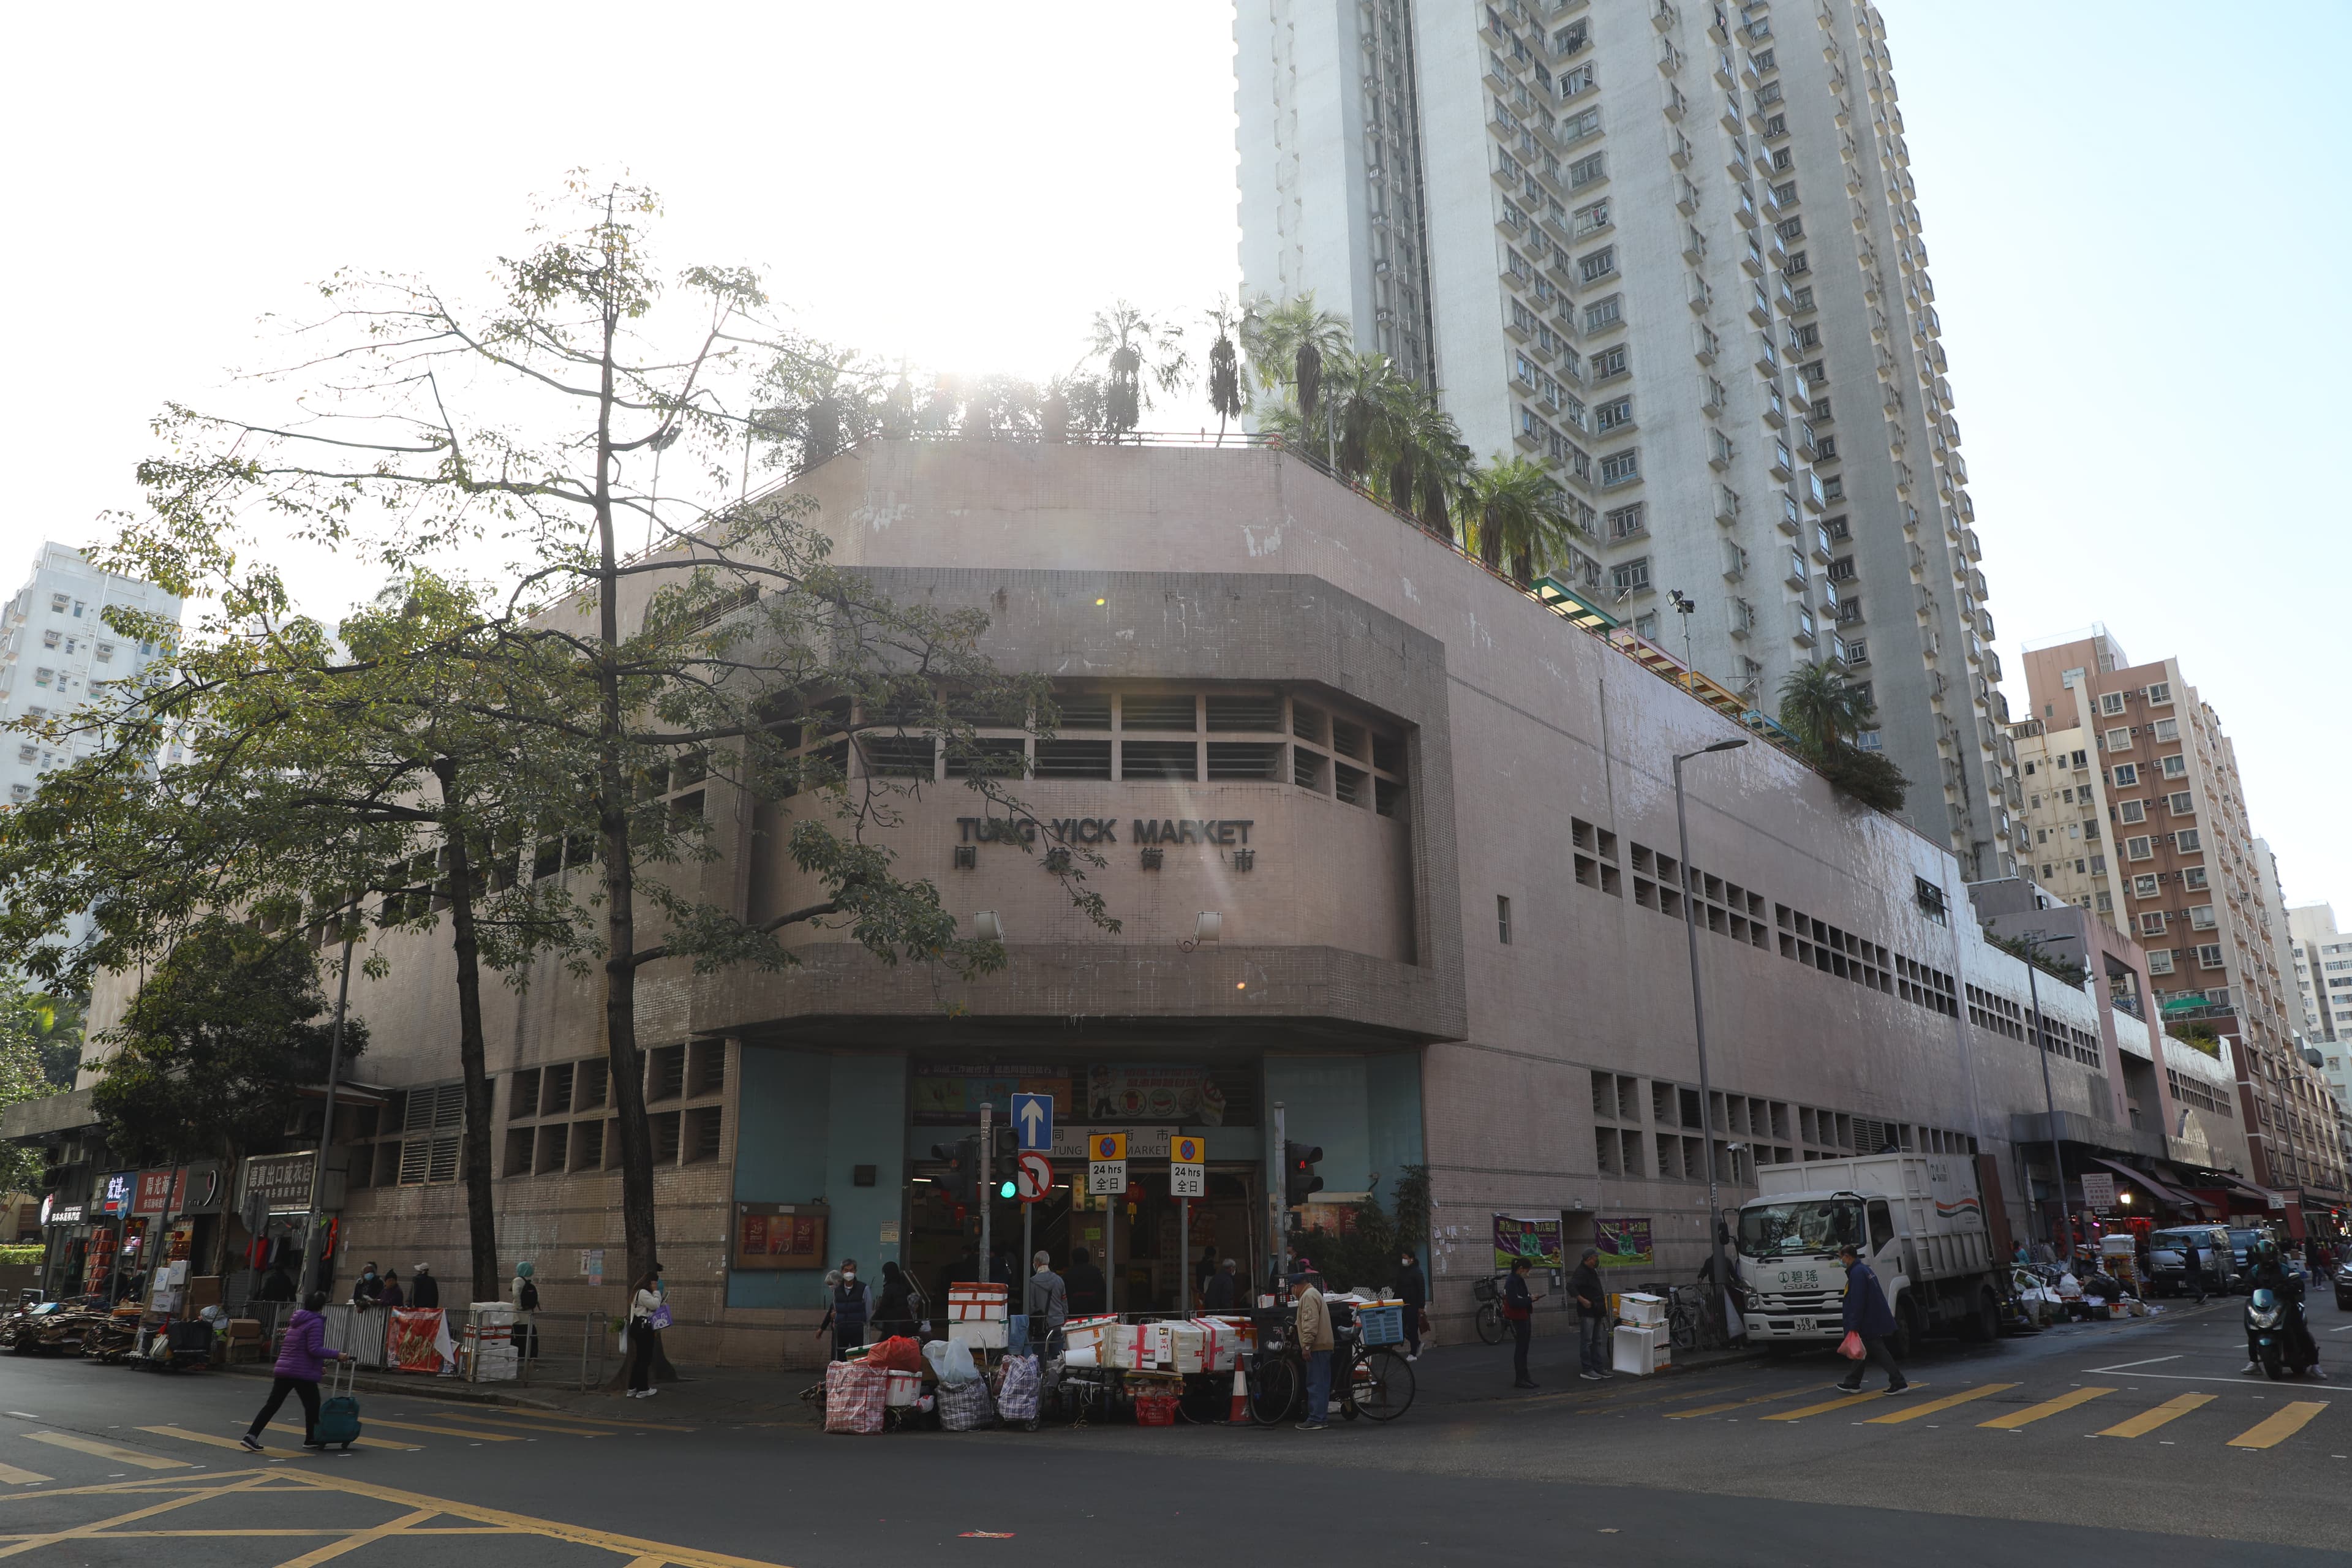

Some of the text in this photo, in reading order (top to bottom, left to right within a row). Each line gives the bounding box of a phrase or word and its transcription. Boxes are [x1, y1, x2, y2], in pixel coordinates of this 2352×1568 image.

[1052, 818, 1117, 843] YICK
[1134, 820, 1254, 844] MARKET
[1054, 1146, 1082, 1155] TUNG
[249, 1159, 312, 1188] 德寶出口成衣店
[1094, 1165, 1121, 1174] 24 hrs
[1175, 1167, 1200, 1177] 24 hrs
[1096, 1178, 1118, 1191] 全日
[1177, 1180, 1197, 1193] 全日
[1791, 1269, 1818, 1283] 碧瑤
